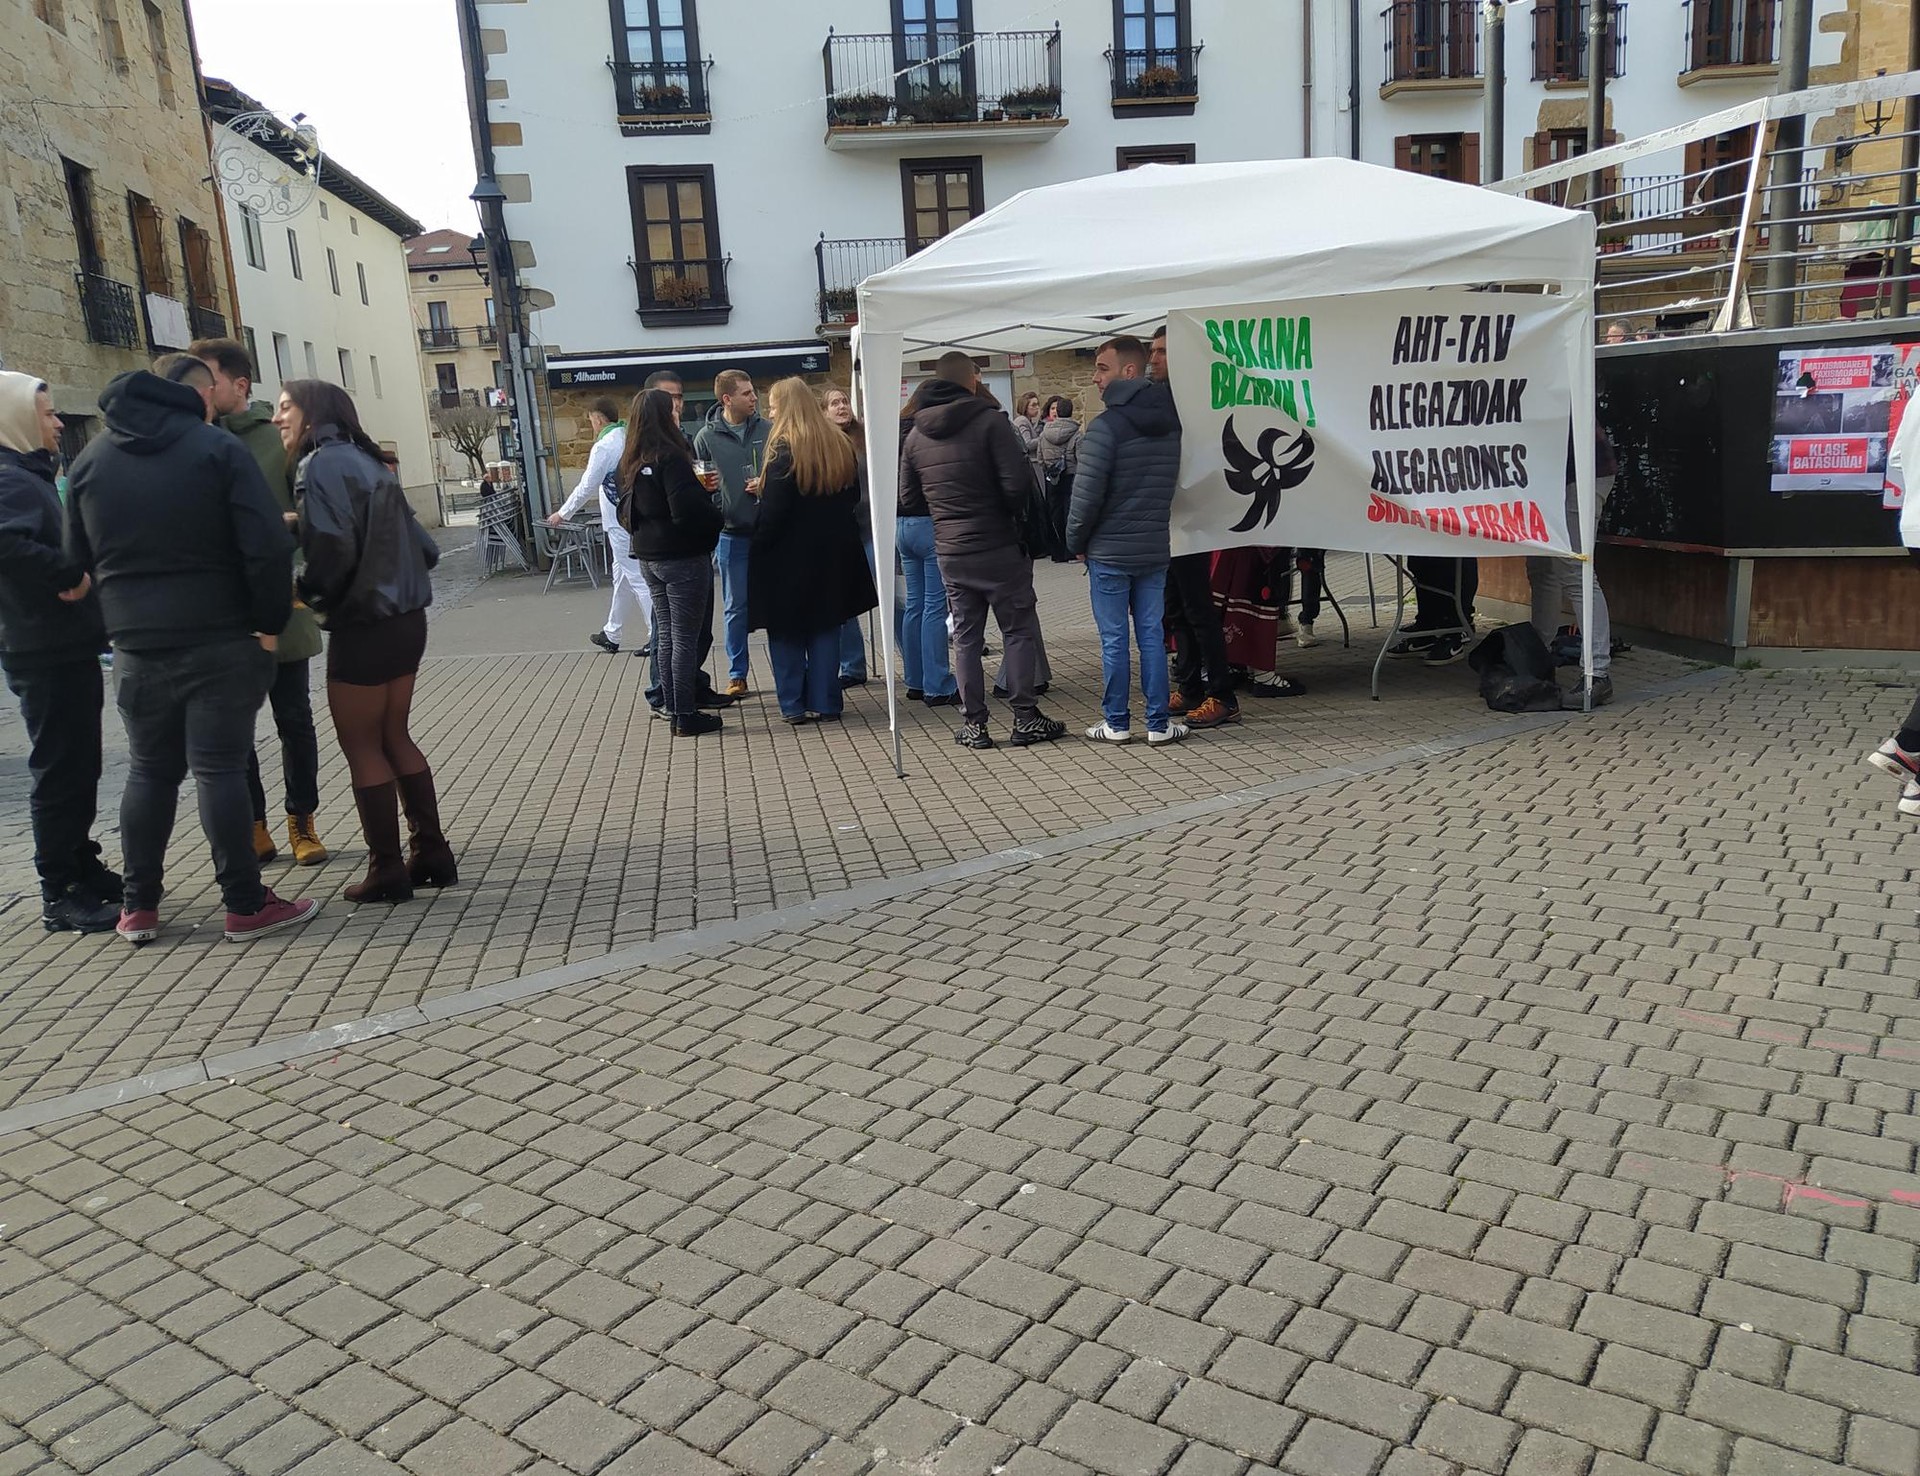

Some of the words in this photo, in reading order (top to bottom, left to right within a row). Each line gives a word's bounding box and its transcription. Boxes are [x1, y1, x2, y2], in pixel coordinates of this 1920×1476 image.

[1205, 317, 1313, 370] SAKANA
[1392, 314, 1515, 365] AHT-TAV
[573, 371, 616, 383] Alhambra
[1369, 378, 1528, 432] ALEGAZIOAK
[1370, 443, 1529, 495] ALEGACIONES
[1793, 456, 1863, 469] BATASUNA!
[1809, 443, 1849, 456] KLASE
[1463, 500, 1550, 543] FIRMA
